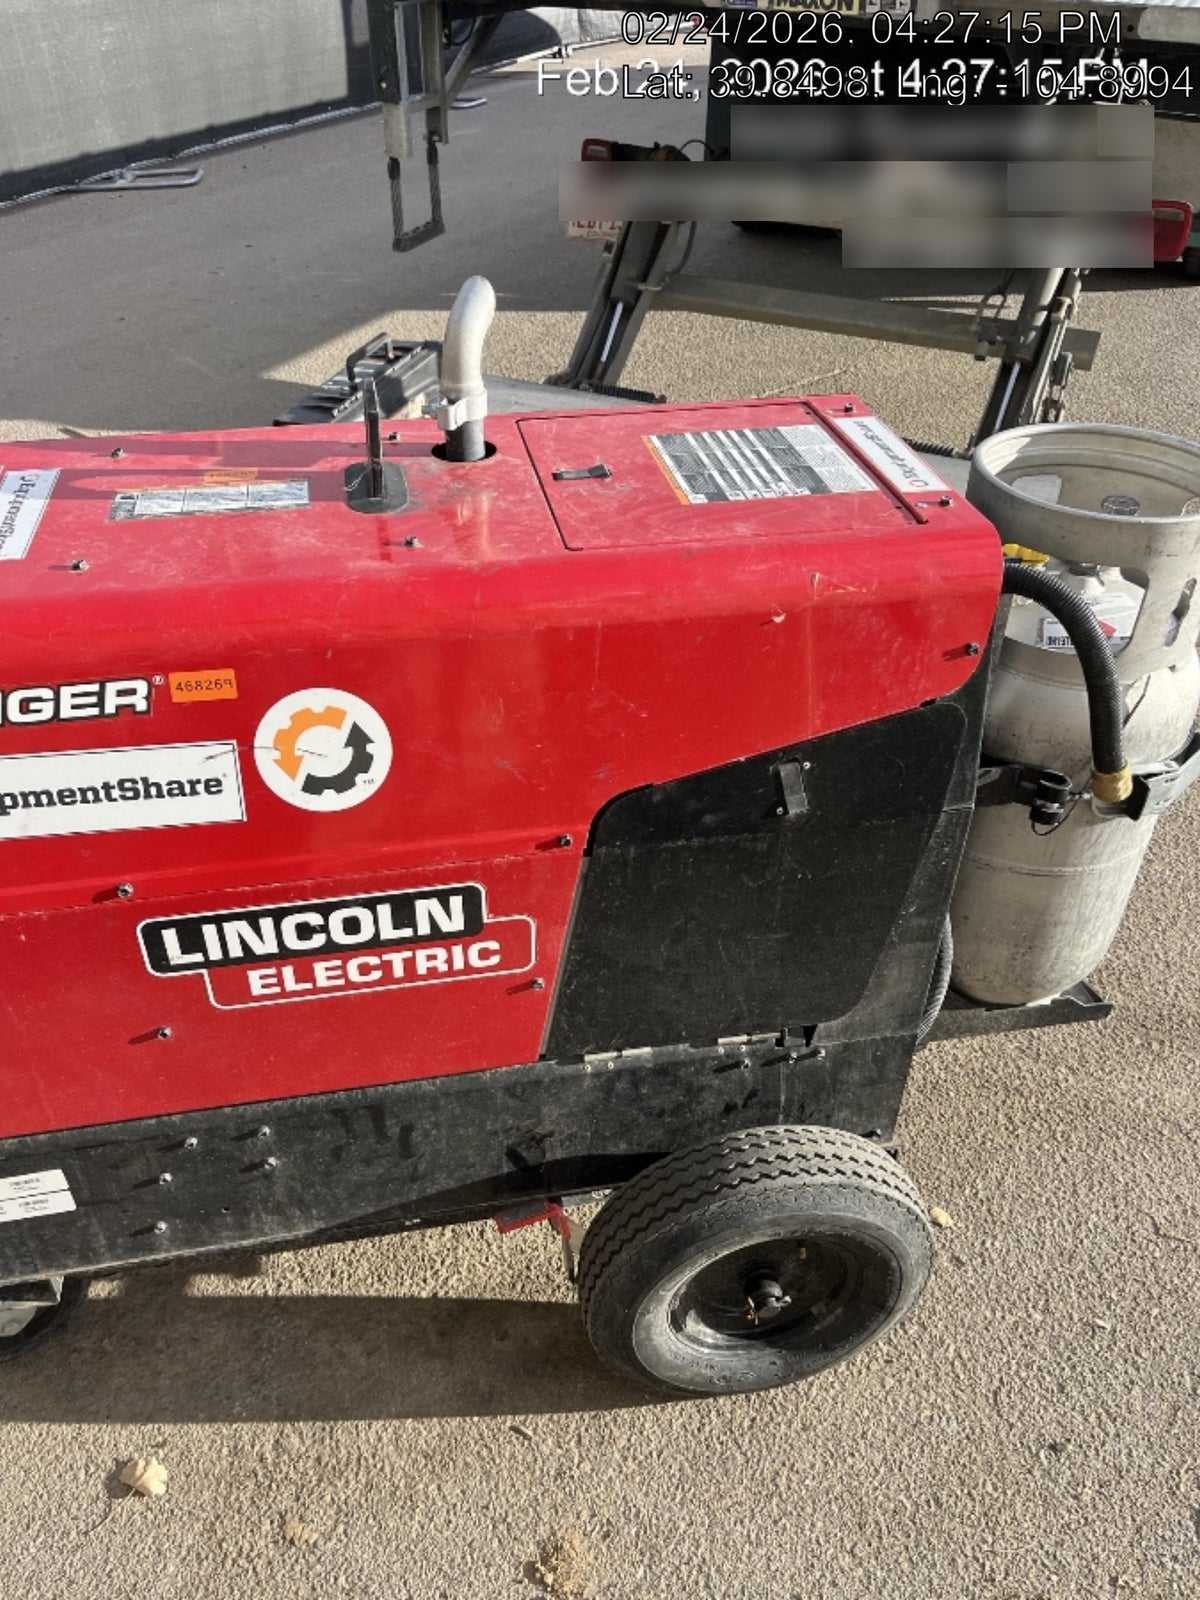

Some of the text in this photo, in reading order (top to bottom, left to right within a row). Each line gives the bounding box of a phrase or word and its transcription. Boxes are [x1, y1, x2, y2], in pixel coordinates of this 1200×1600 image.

[0, 678, 149, 724] GER
[161, 895, 465, 966] LINCOLN
[247, 940, 501, 997] ELECTRIC
